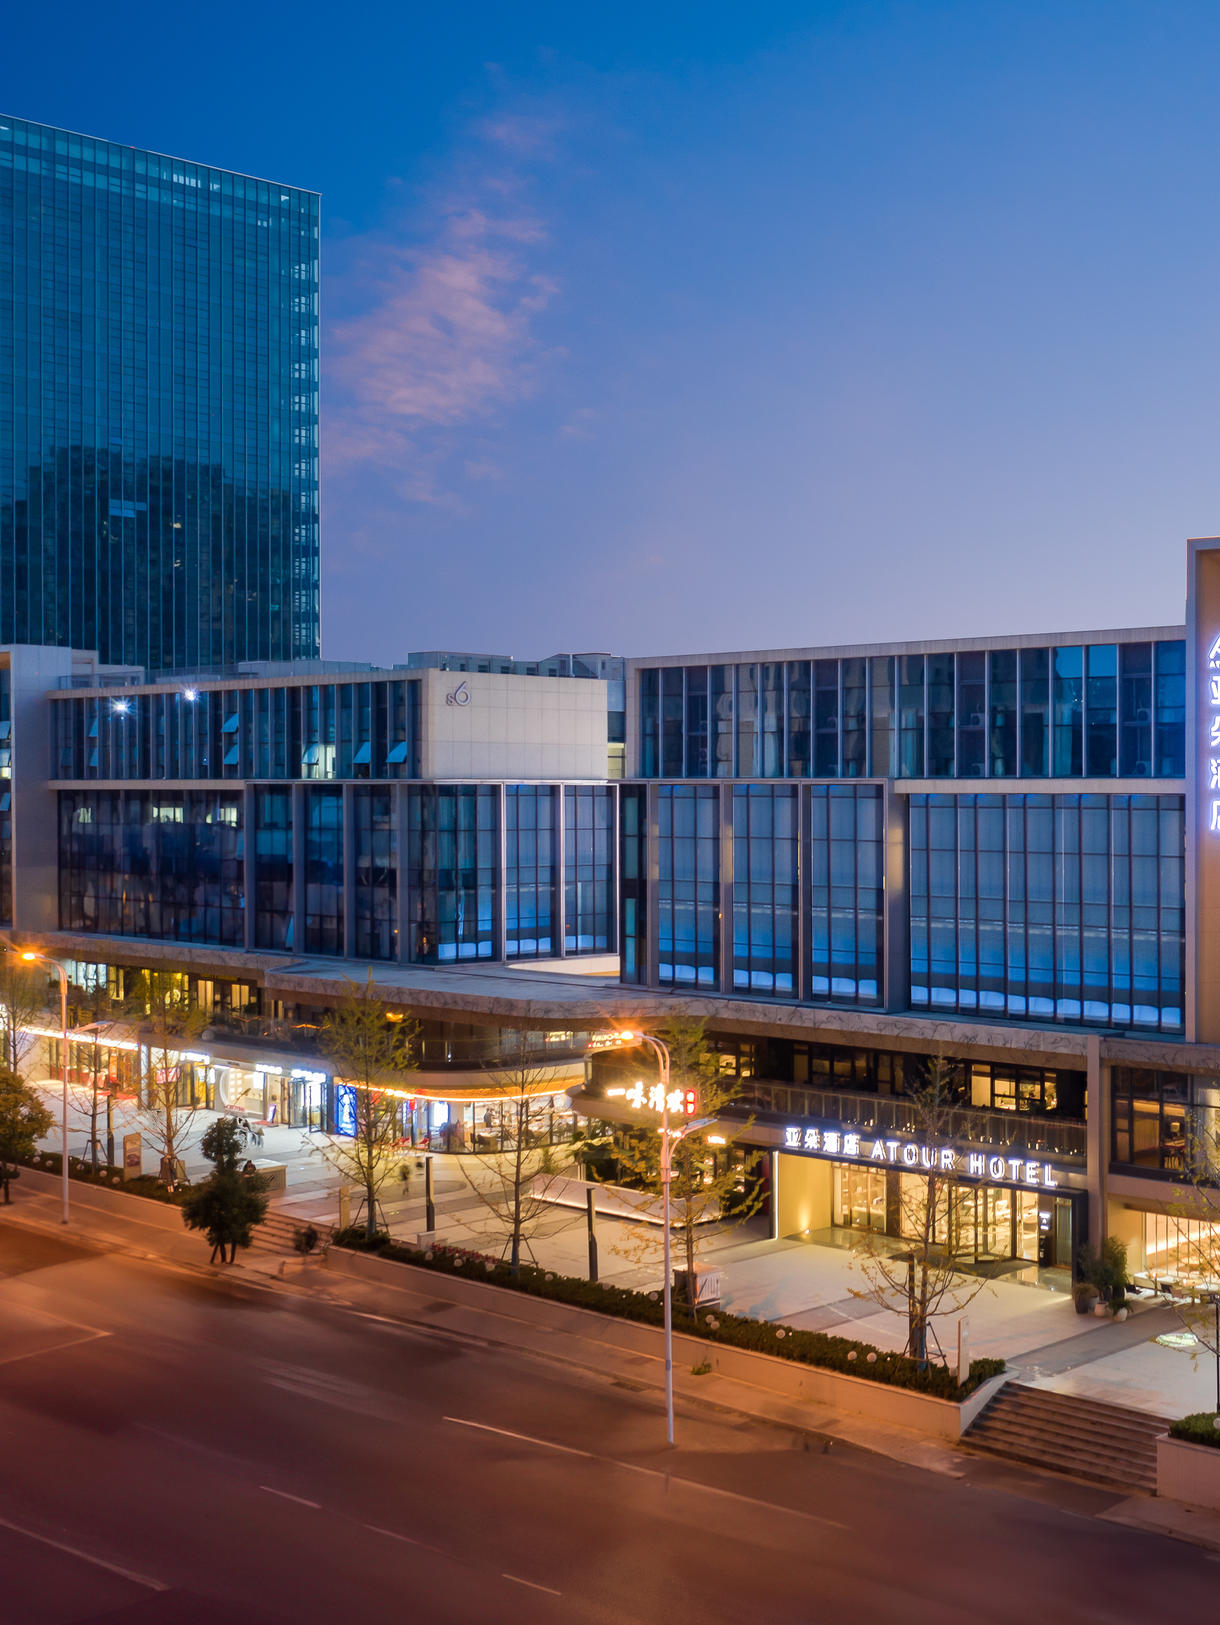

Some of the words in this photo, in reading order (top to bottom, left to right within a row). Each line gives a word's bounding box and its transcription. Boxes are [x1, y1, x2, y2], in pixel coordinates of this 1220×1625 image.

[785, 1126, 861, 1155] 亚朵酒店
[871, 1139, 956, 1169] ATOUR
[969, 1152, 1058, 1187] HOTEL
